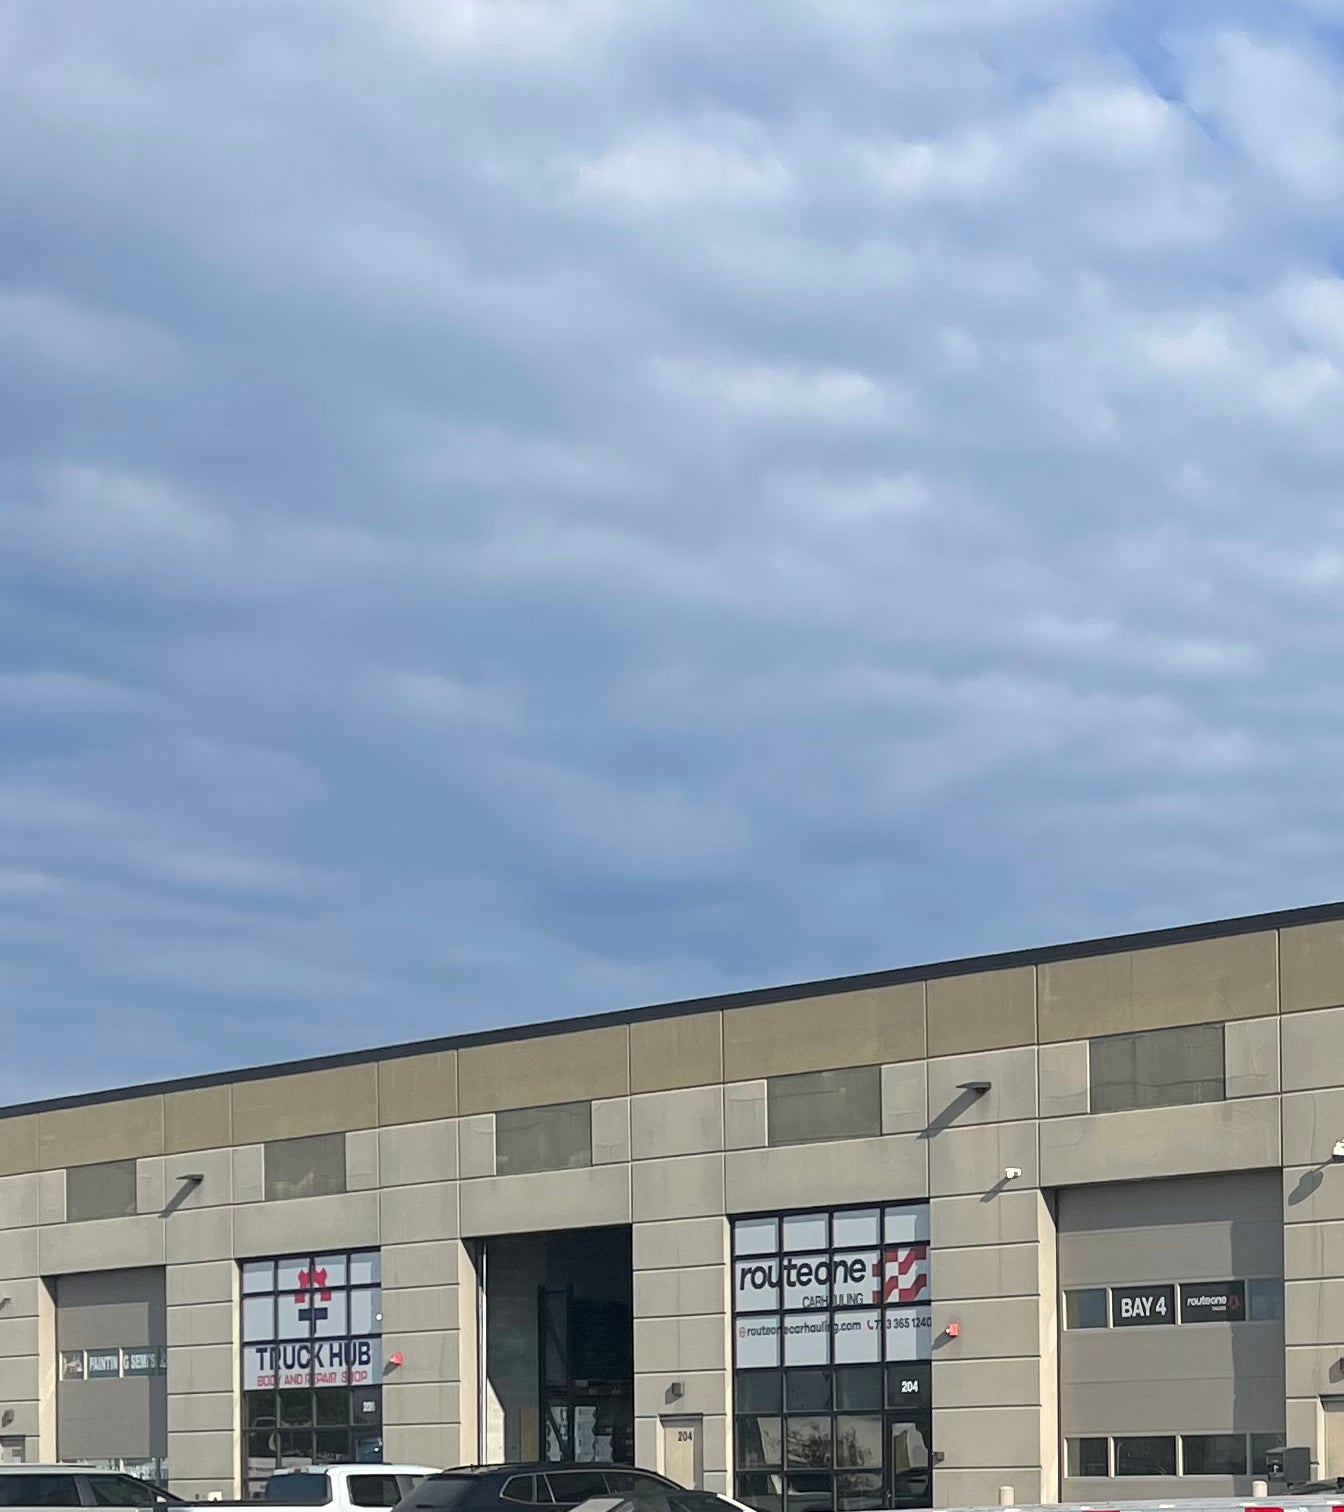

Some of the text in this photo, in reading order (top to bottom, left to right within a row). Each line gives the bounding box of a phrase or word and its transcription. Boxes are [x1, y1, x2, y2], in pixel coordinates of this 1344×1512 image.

[740, 1257, 867, 1291] routeone
[802, 1292, 864, 1308] CARHULING
[1121, 1296, 1167, 1318] BAY 4
[1187, 1295, 1227, 1306] routeone
[874, 1316, 932, 1330] 73 365 1240
[255, 1340, 372, 1371] TRUCK HUB
[284, 1373, 303, 1385] AND
[305, 1371, 337, 1385] RPAIR
[901, 1380, 919, 1393] 204
[677, 1431, 693, 1442] 204
